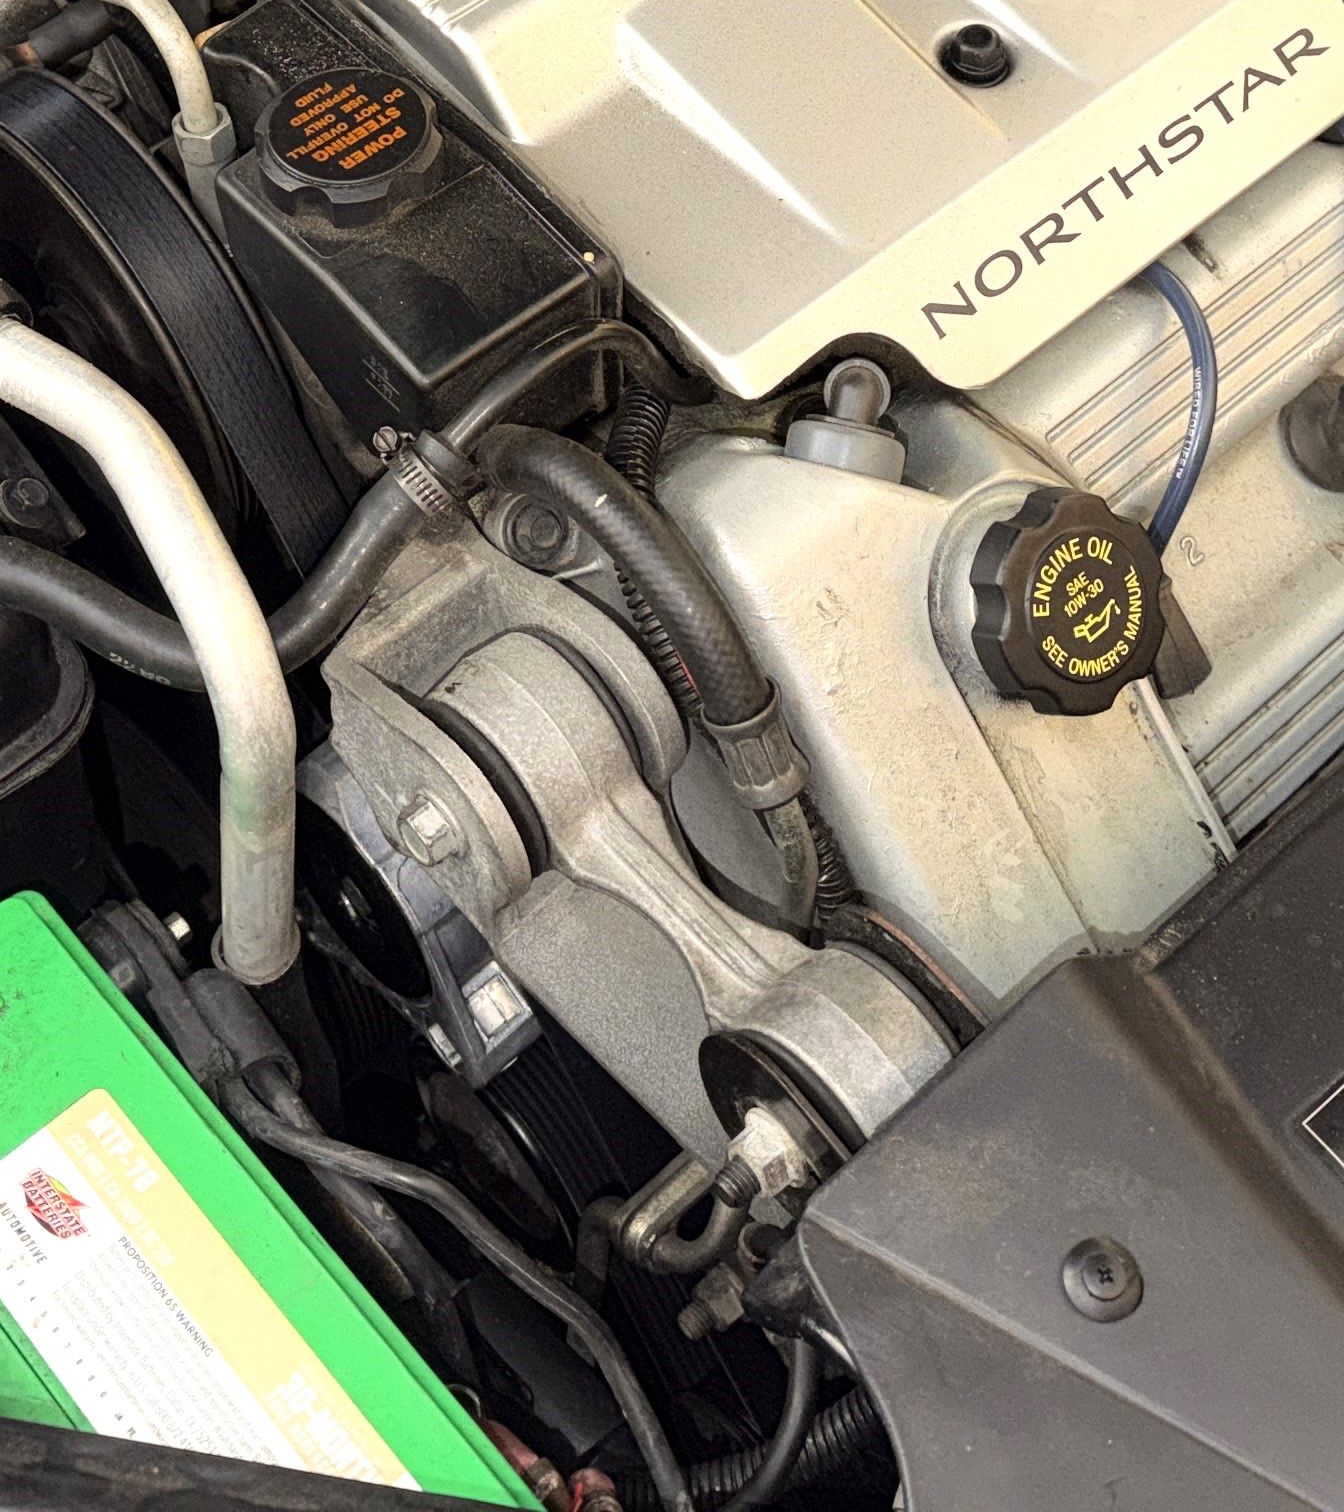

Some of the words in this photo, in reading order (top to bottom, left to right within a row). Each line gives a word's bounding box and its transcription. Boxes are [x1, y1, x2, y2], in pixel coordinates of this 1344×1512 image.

[288, 83, 357, 127] APPROVED
[294, 82, 333, 109] FLUID
[340, 94, 369, 114] USE
[354, 102, 382, 123] NOT
[382, 87, 405, 104] DO
[285, 121, 348, 160] OVERFILL
[304, 113, 337, 137] ONLY
[311, 106, 402, 162] STEERING
[338, 125, 407, 170] POWER
[921, 27, 1330, 341] NORTHSTAR
[1033, 537, 1083, 617] ENGINE
[1087, 536, 1114, 565] OIL
[1064, 578, 1104, 617] 10W-30
[1065, 571, 1090, 597] SAE
[1042, 635, 1069, 668] SEE
[1068, 640, 1129, 677] OWNER'S
[1123, 565, 1143, 641] MANUAL
[21, 1180, 72, 1239] BATTERIES
[29, 1170, 87, 1236] INTERSTATE
[118, 1236, 167, 1299] PROPOSITION
[165, 1296, 178, 1312] 65
[175, 1309, 214, 1358] WARNING
